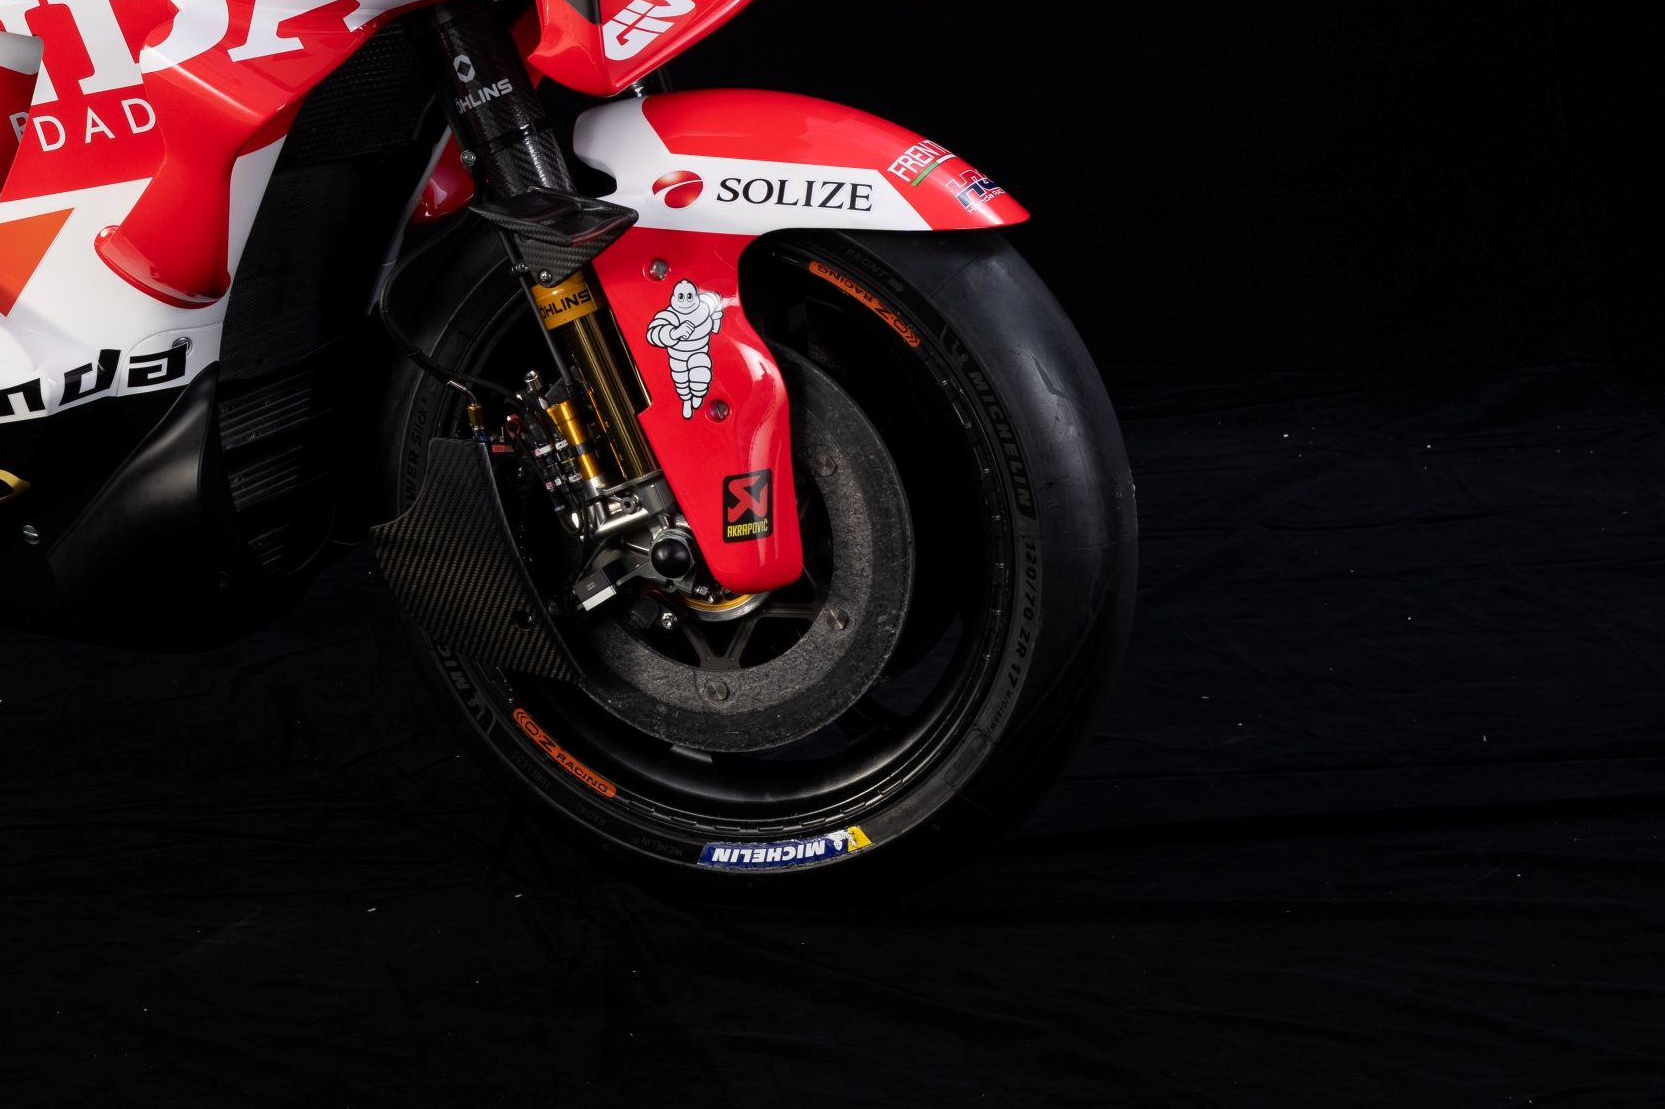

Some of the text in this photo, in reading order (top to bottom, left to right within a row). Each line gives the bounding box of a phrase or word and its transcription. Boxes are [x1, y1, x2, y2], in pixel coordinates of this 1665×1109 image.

[716, 177, 873, 212] SOLIZE
[817, 263, 874, 304] RACING
[968, 370, 1033, 508] MICHELIN
[556, 751, 610, 795] RACING
[712, 839, 826, 864] MICHELIN
